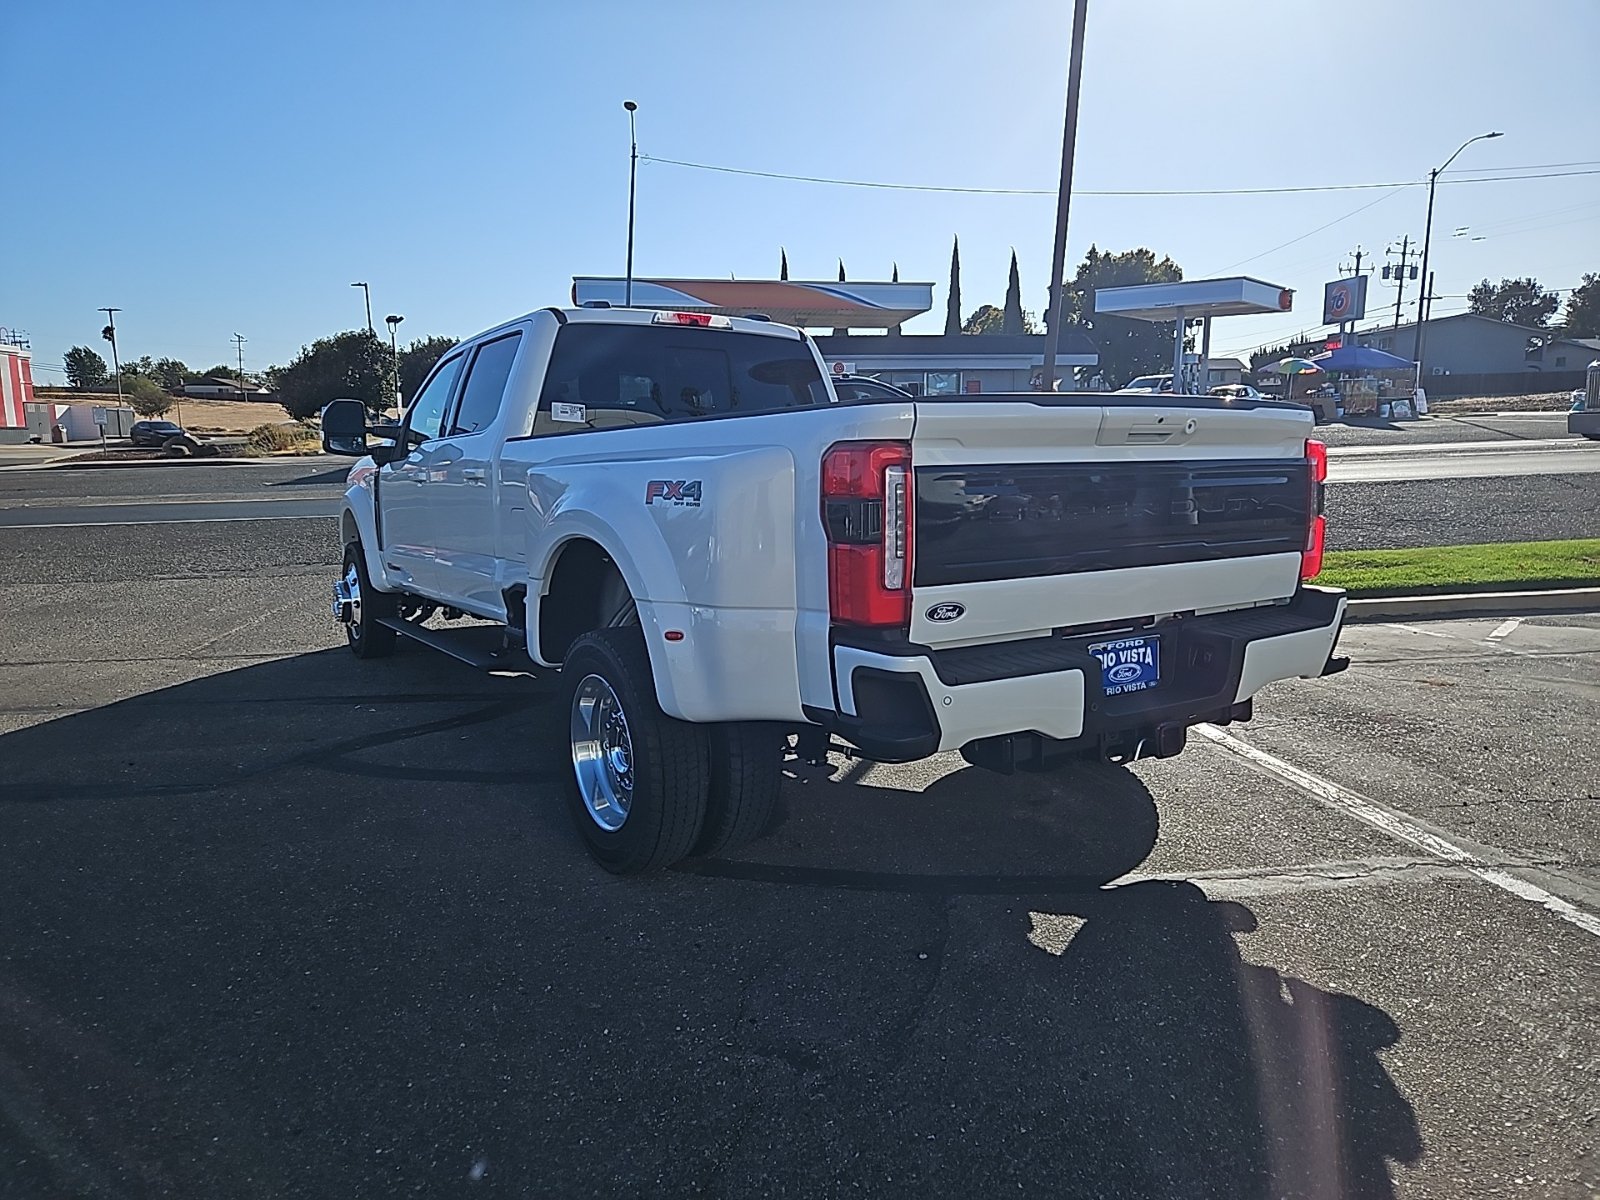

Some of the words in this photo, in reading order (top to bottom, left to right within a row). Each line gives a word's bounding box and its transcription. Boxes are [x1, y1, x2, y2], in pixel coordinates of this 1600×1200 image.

[1331, 290, 1346, 311] 76
[645, 480, 702, 505] FX4
[934, 606, 959, 619] Ford
[1107, 640, 1144, 650] FORD
[1119, 647, 1153, 666] VISTA
[1117, 668, 1133, 678] Ford
[1106, 686, 1121, 695] RIO
[1123, 682, 1147, 692] VISTA
